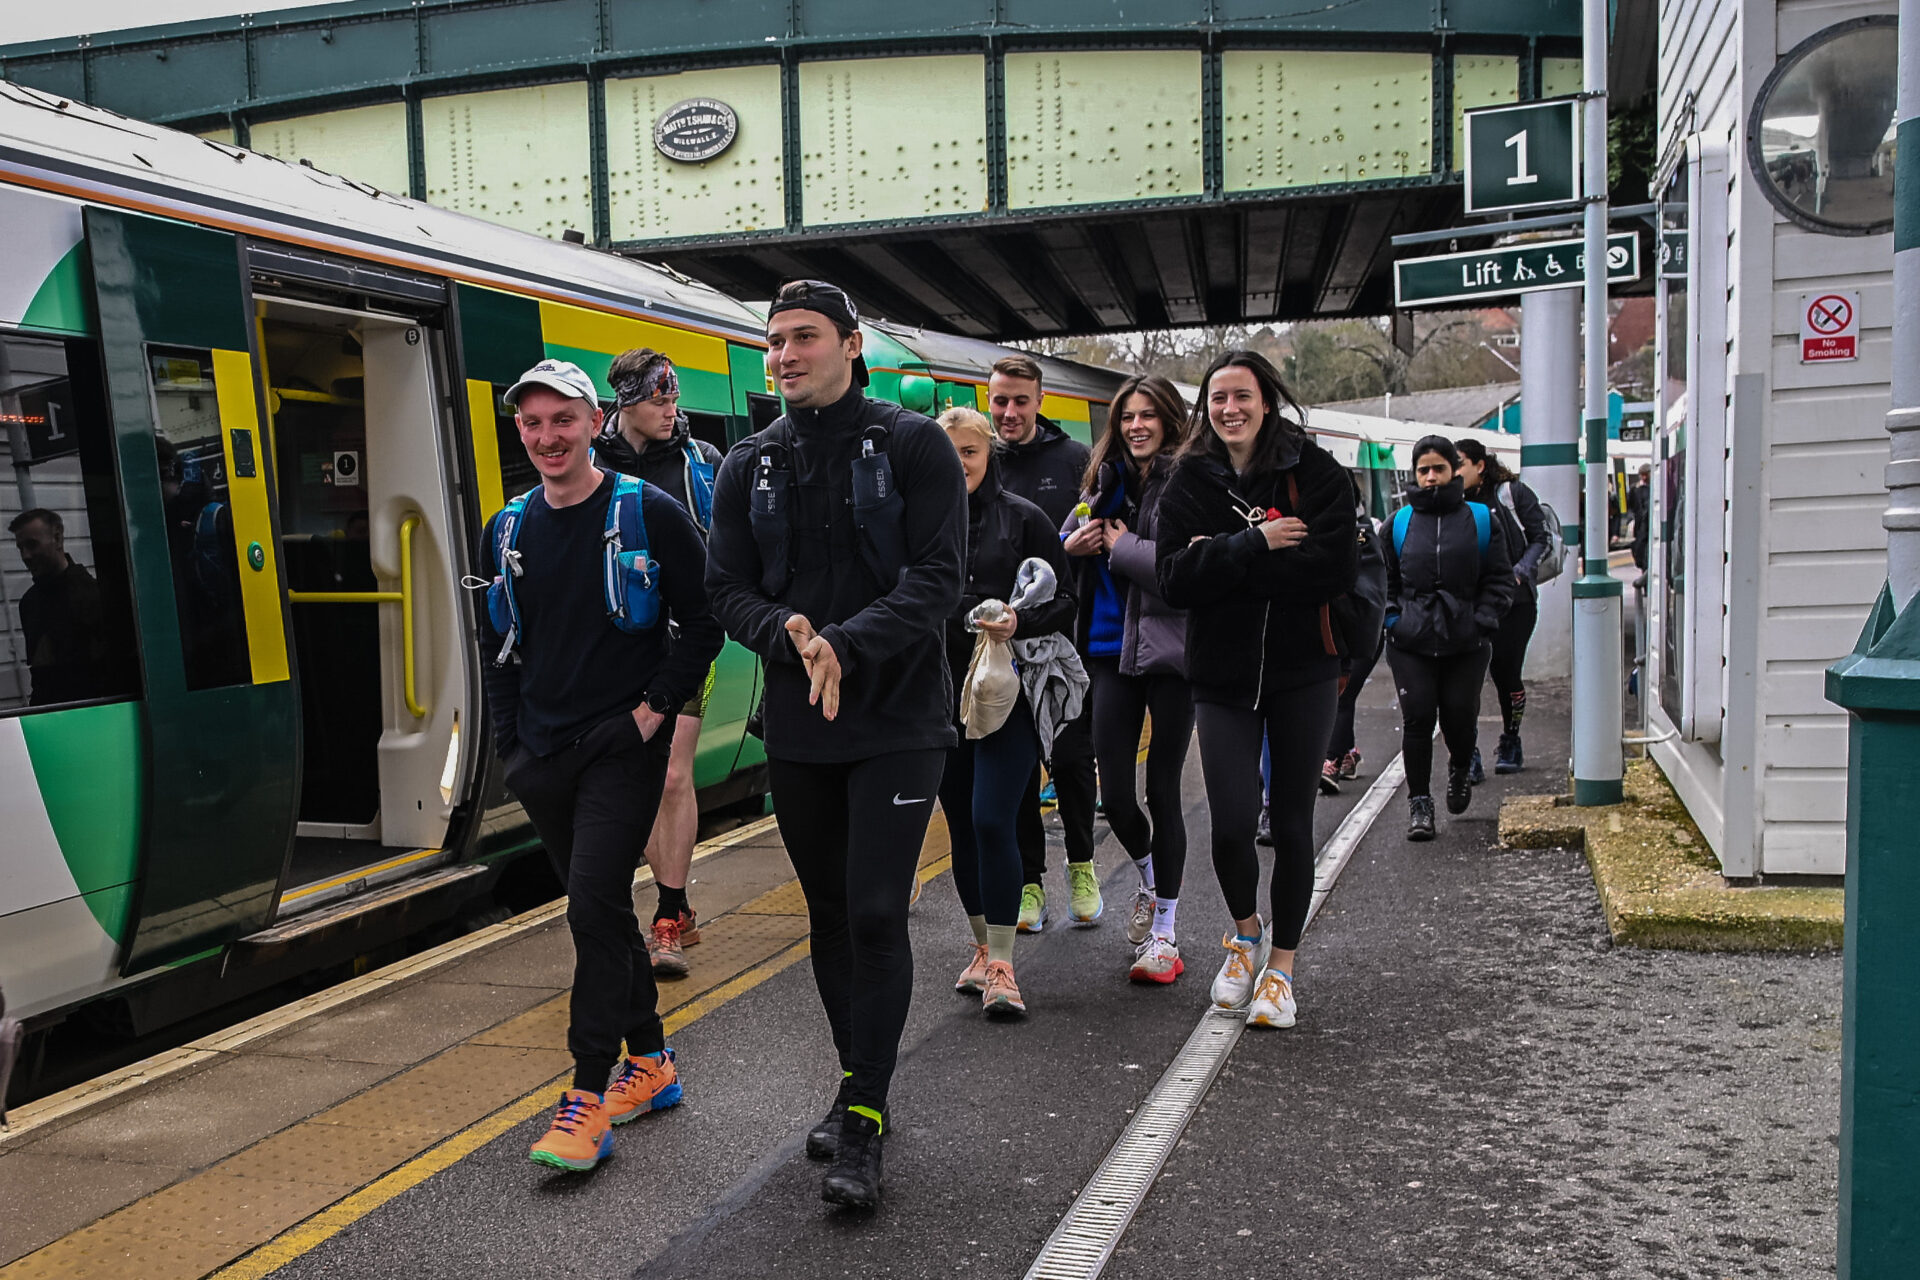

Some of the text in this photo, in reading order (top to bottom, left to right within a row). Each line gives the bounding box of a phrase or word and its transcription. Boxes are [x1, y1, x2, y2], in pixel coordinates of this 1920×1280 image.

[1505, 129, 1537, 185] 1
[1462, 260, 1502, 287] Lift
[409, 330, 417, 341] B
[1822, 339, 1836, 348] No
[1808, 348, 1850, 358] Smoking
[343, 459, 349, 469] 1
